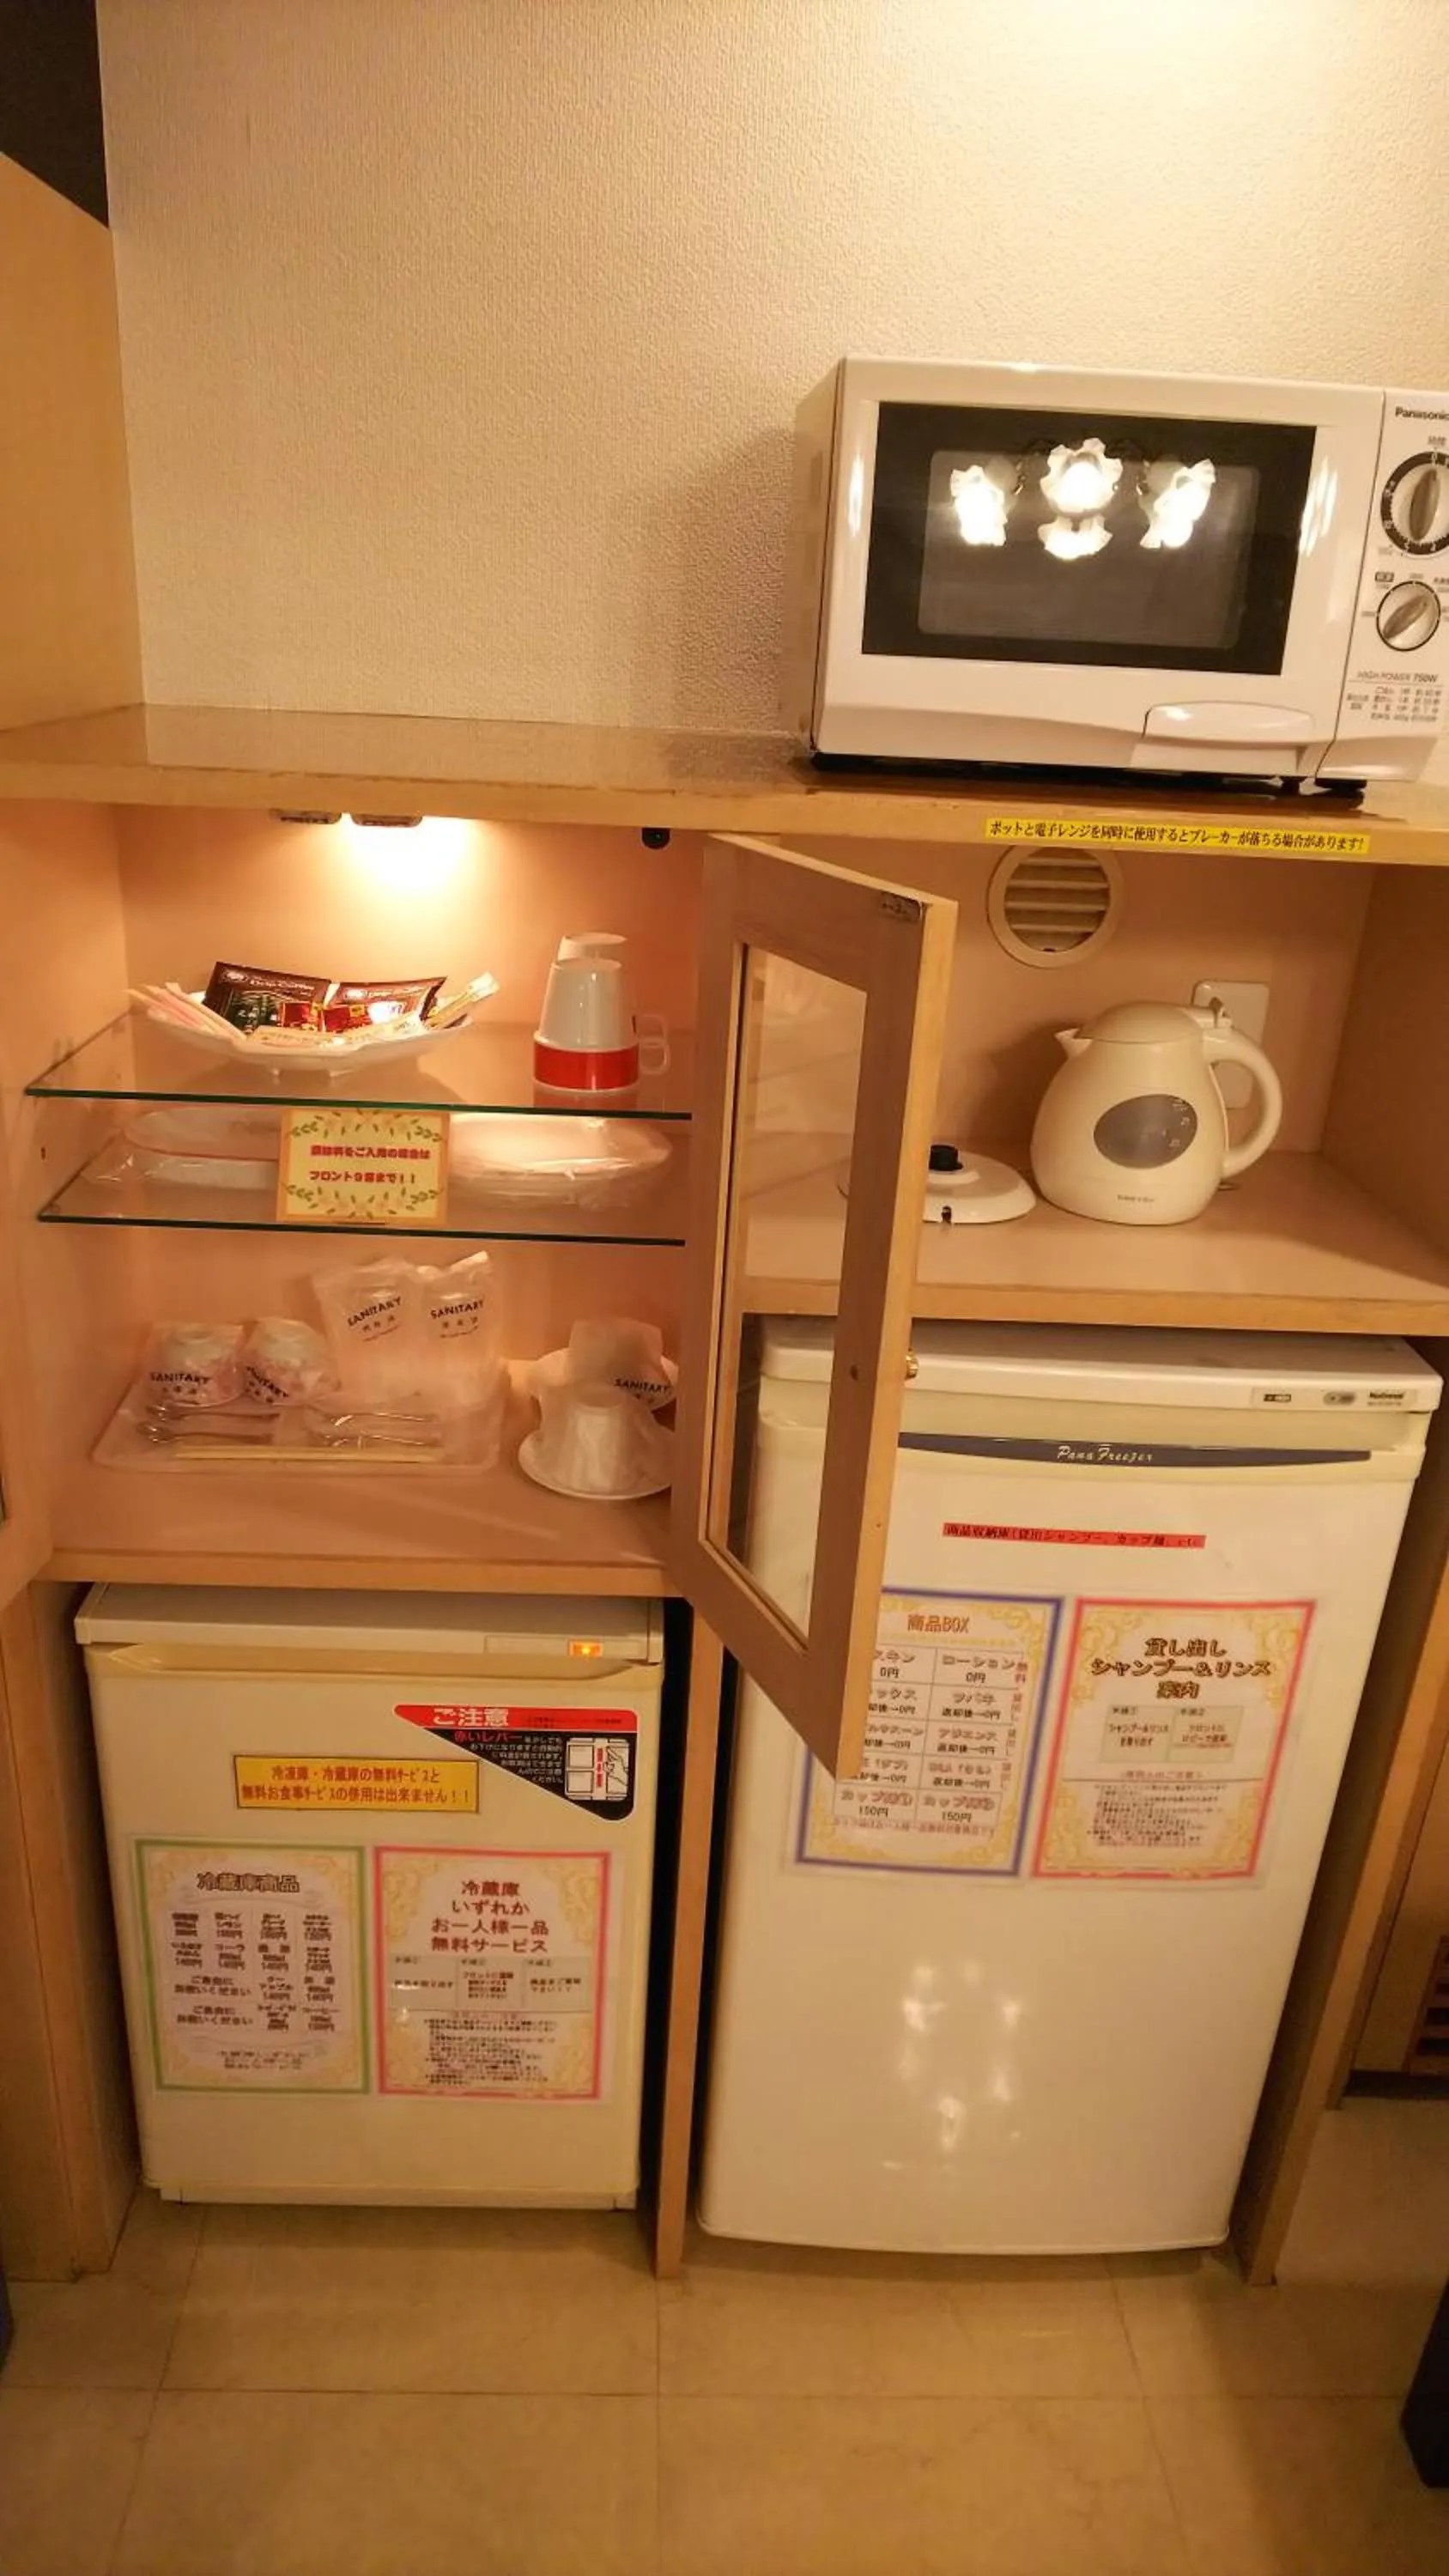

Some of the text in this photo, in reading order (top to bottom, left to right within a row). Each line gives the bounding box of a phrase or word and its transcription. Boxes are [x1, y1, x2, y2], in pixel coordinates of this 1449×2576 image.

[347, 1296, 402, 1327] SANITARY
[430, 1299, 484, 1320] SANITARY
[150, 1371, 214, 1386] SANITARY
[1097, 1443, 1153, 1464] Freezer
[875, 1688, 918, 1701] ックス
[433, 1707, 509, 1728] ご注意
[462, 1880, 519, 1897] 冷蔵庫
[452, 1899, 530, 1916] いずれか
[431, 1917, 549, 1935] お一人様一品
[432, 1937, 548, 1953] 無料サービス
